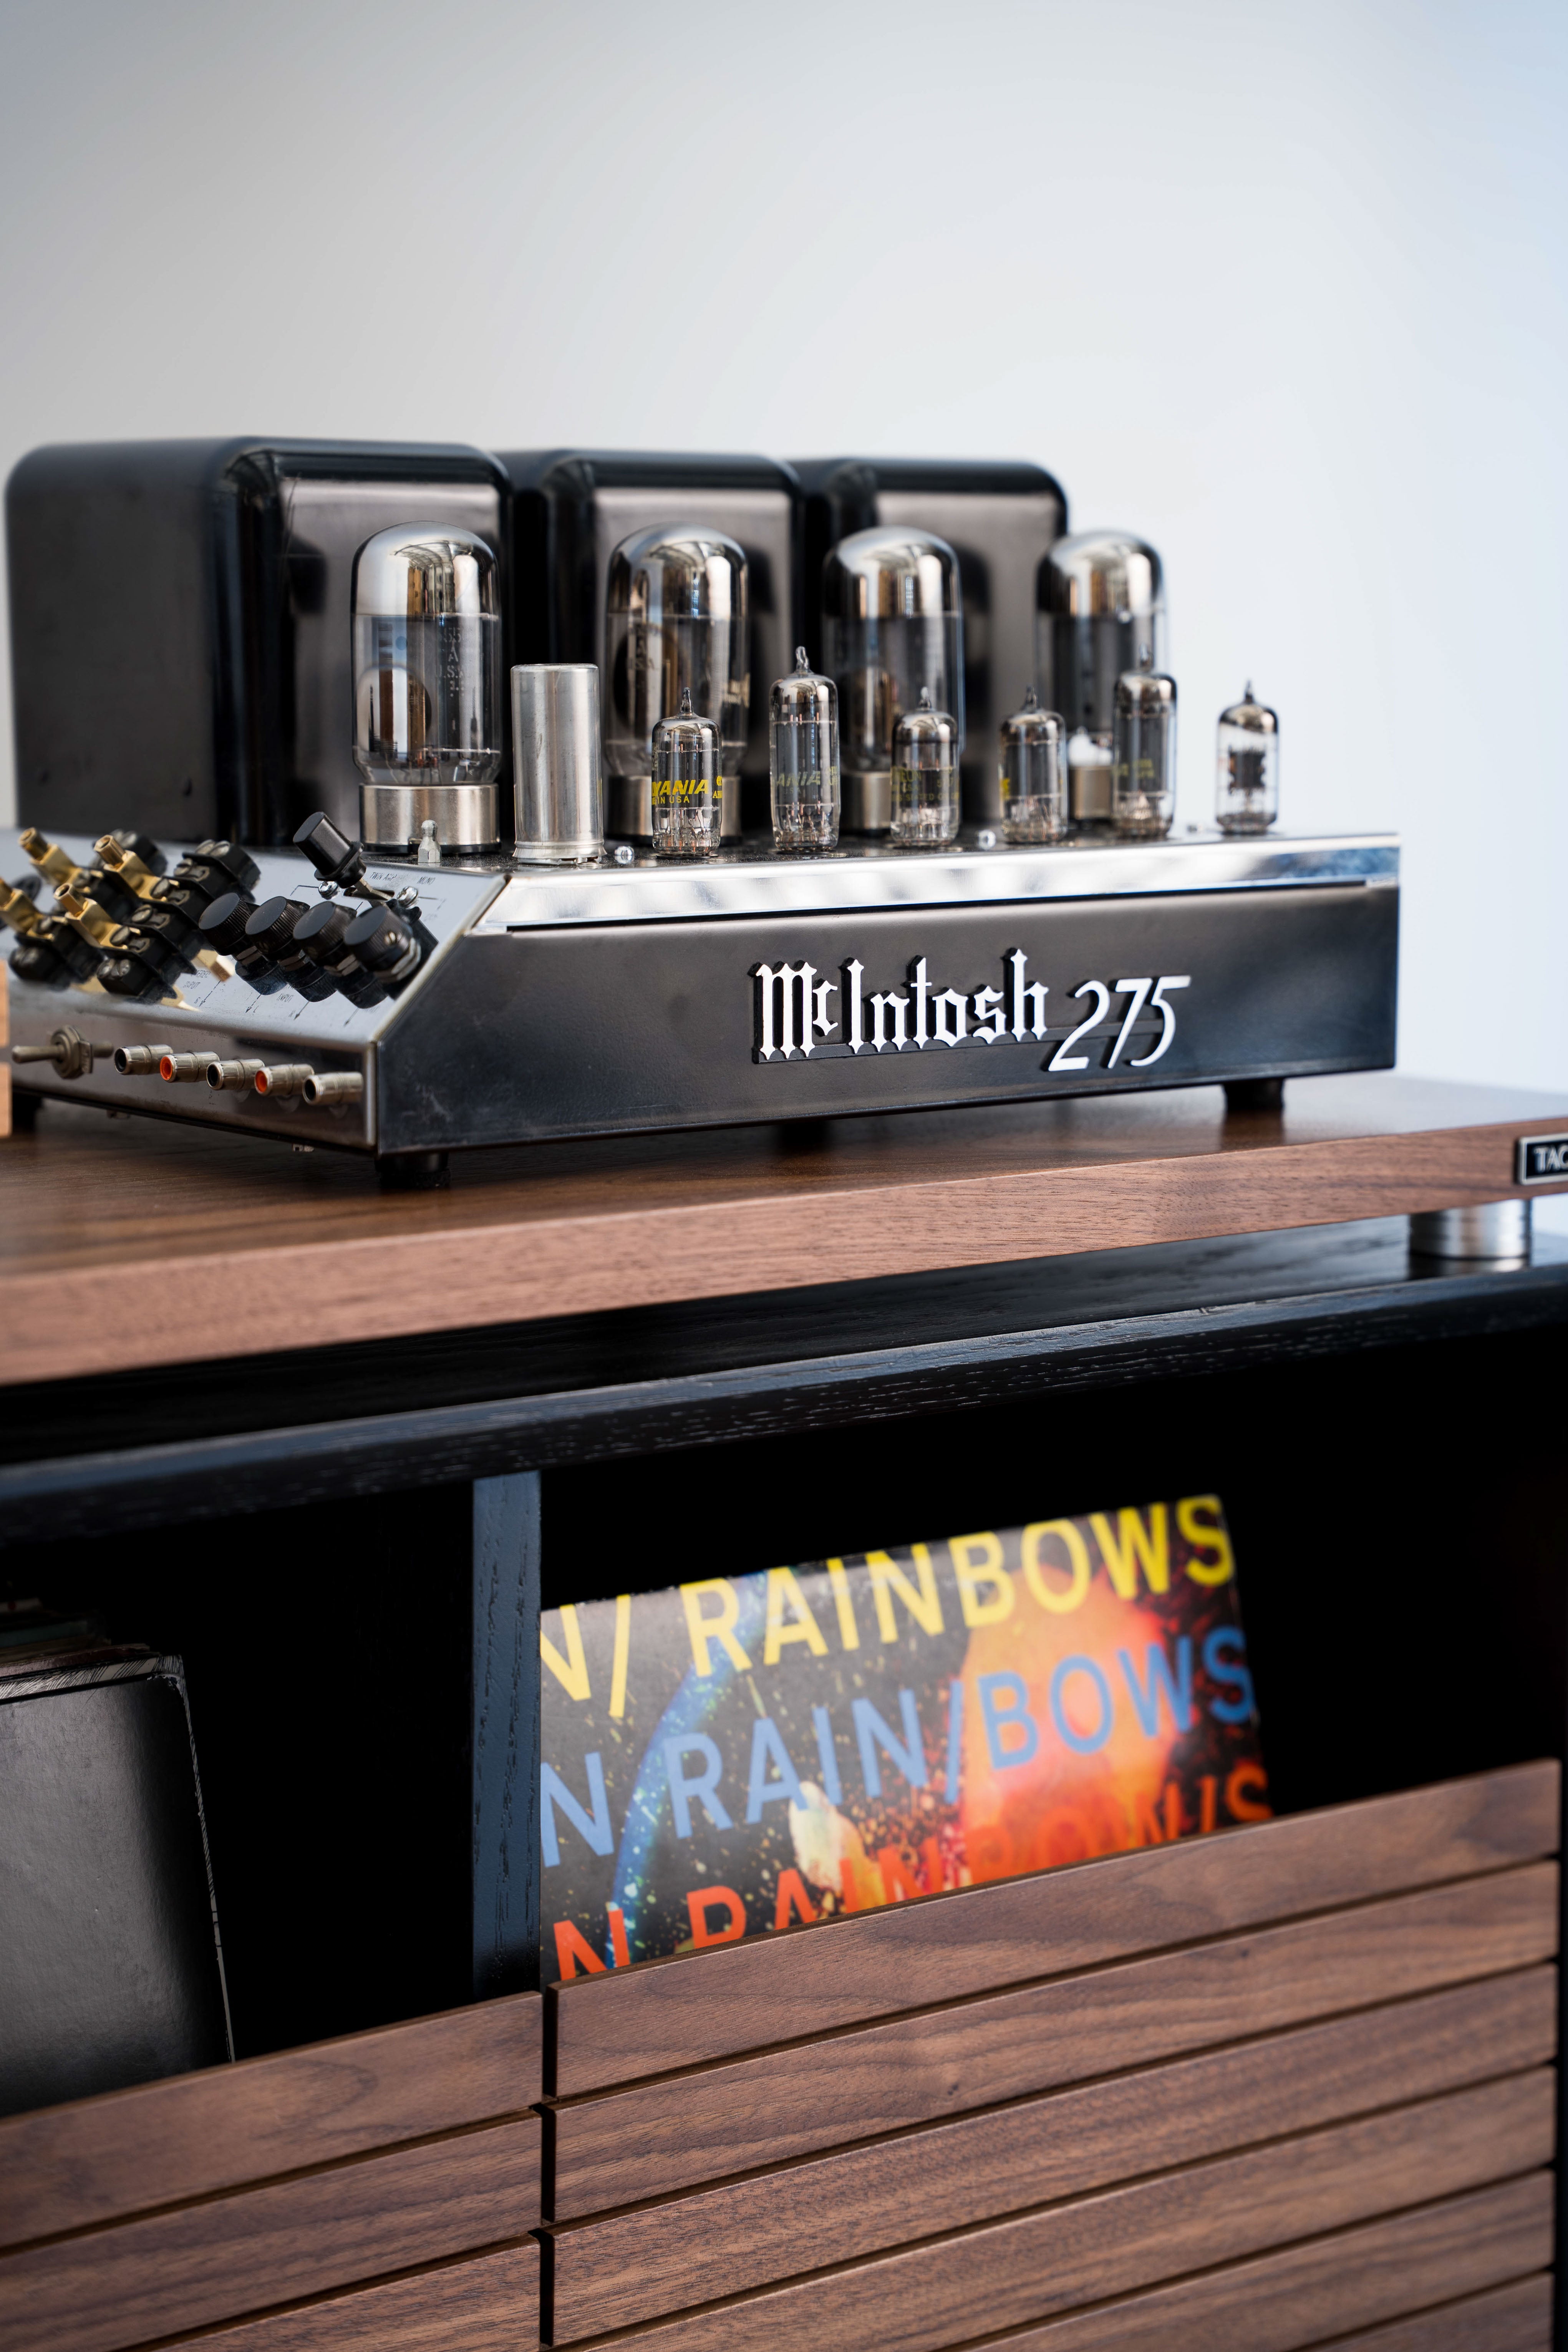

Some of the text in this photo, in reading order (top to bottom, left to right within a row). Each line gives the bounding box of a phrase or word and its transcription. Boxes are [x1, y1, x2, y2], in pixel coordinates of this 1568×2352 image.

[669, 796, 690, 804] USA
[370, 872, 383, 881] TWIN
[417, 876, 436, 885] MONO
[755, 948, 1191, 1072] McIntosh 275
[680, 1495, 1234, 1677] RAINBOWS
[540, 1626, 1257, 1868] N RAIN/BOWS
